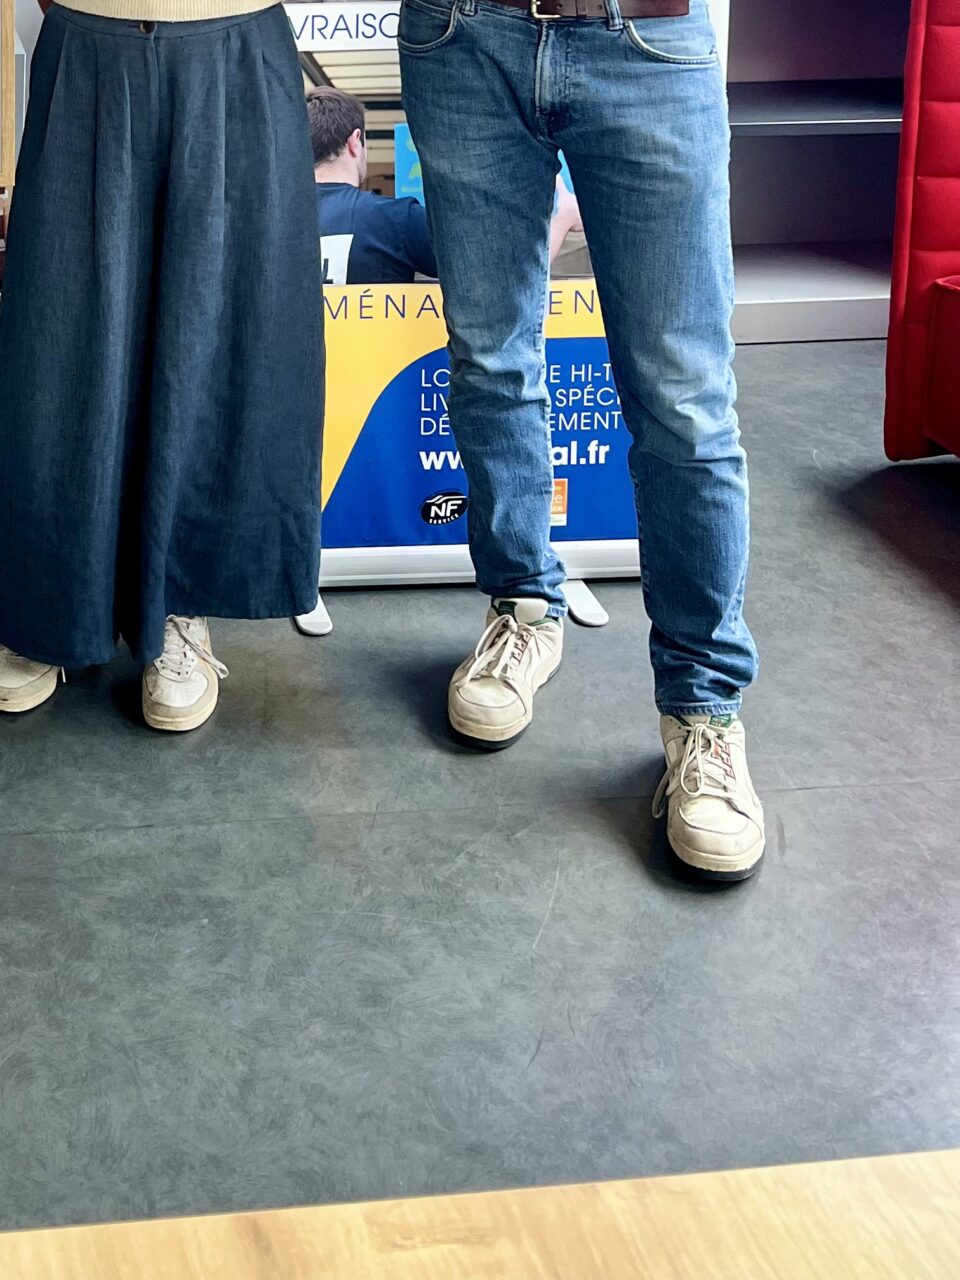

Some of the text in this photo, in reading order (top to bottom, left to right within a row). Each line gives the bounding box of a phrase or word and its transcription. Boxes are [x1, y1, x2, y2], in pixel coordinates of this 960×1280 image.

[287, 13, 400, 40] VRAISO
[323, 289, 595, 320] MÉNA EN
[571, 363, 611, 383] HI-T
[548, 410, 622, 432] EMENT
[552, 439, 611, 466] al.fr
[428, 513, 460, 525] SERVICE
[430, 500, 463, 518] NF
